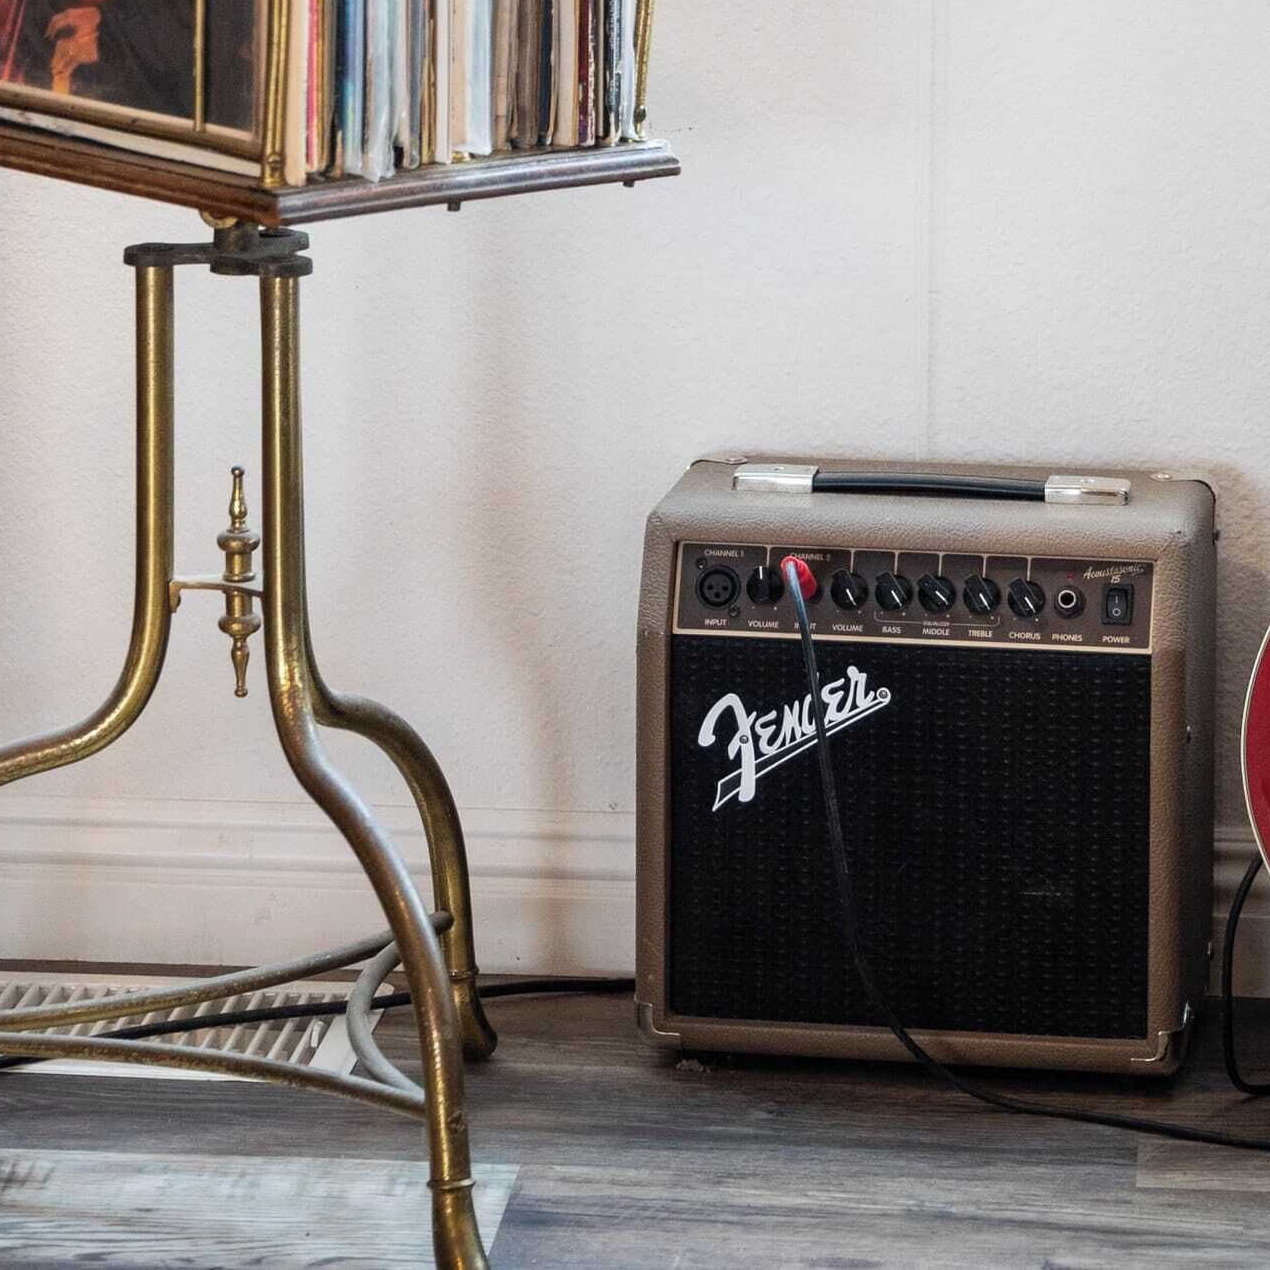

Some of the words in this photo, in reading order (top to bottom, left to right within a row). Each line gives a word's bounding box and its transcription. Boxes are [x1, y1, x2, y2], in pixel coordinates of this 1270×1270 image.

[704, 548, 739, 558] CHANNEL
[1111, 574, 1121, 584] 15
[704, 618, 728, 627] INPUT
[747, 619, 779, 628] VOLUME
[832, 623, 864, 632] VOLUME
[881, 625, 902, 634] BASS
[922, 627, 950, 636] MIDDLE
[968, 629, 994, 638] TREBLE
[1008, 631, 1041, 640] CHORUS
[1051, 633, 1083, 642] PHONES
[1102, 635, 1130, 644] POWER
